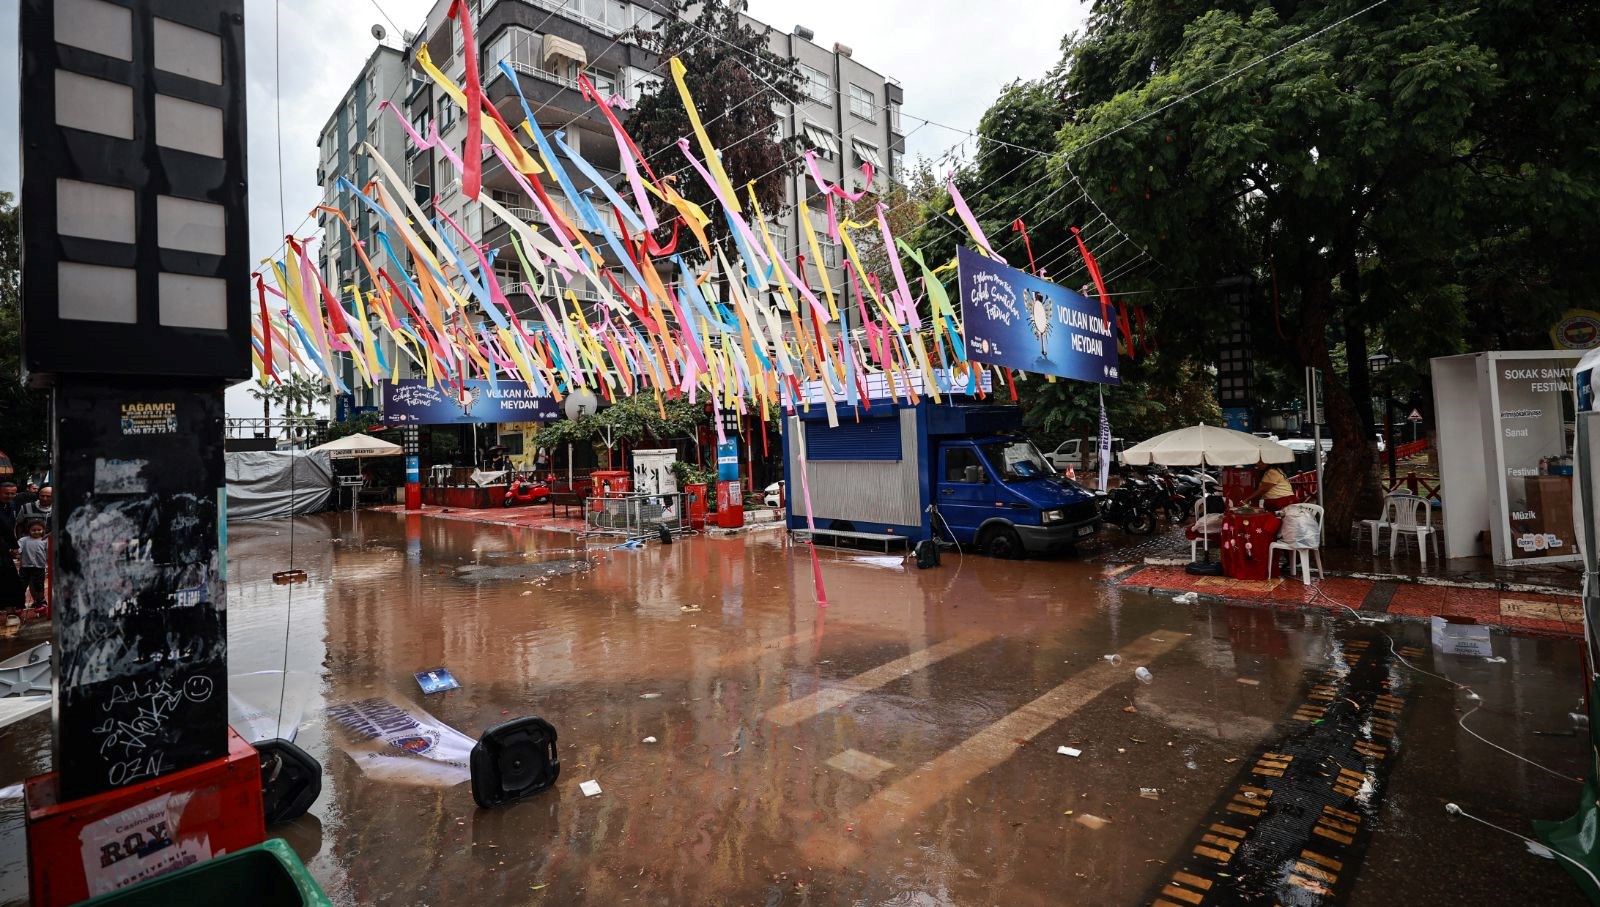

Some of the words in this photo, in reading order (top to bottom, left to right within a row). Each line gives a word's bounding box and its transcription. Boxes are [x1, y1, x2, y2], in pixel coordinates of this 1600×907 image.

[1057, 305, 1088, 331] VOLKAN
[1071, 333, 1103, 356] MEYDANI
[1505, 369, 1539, 380] SOKAK
[1541, 368, 1574, 378] SANAT
[500, 400, 539, 409] MEYDANI
[1505, 428, 1528, 437] Sanat
[1507, 467, 1539, 477] Festival
[1512, 511, 1536, 520] Müzik
